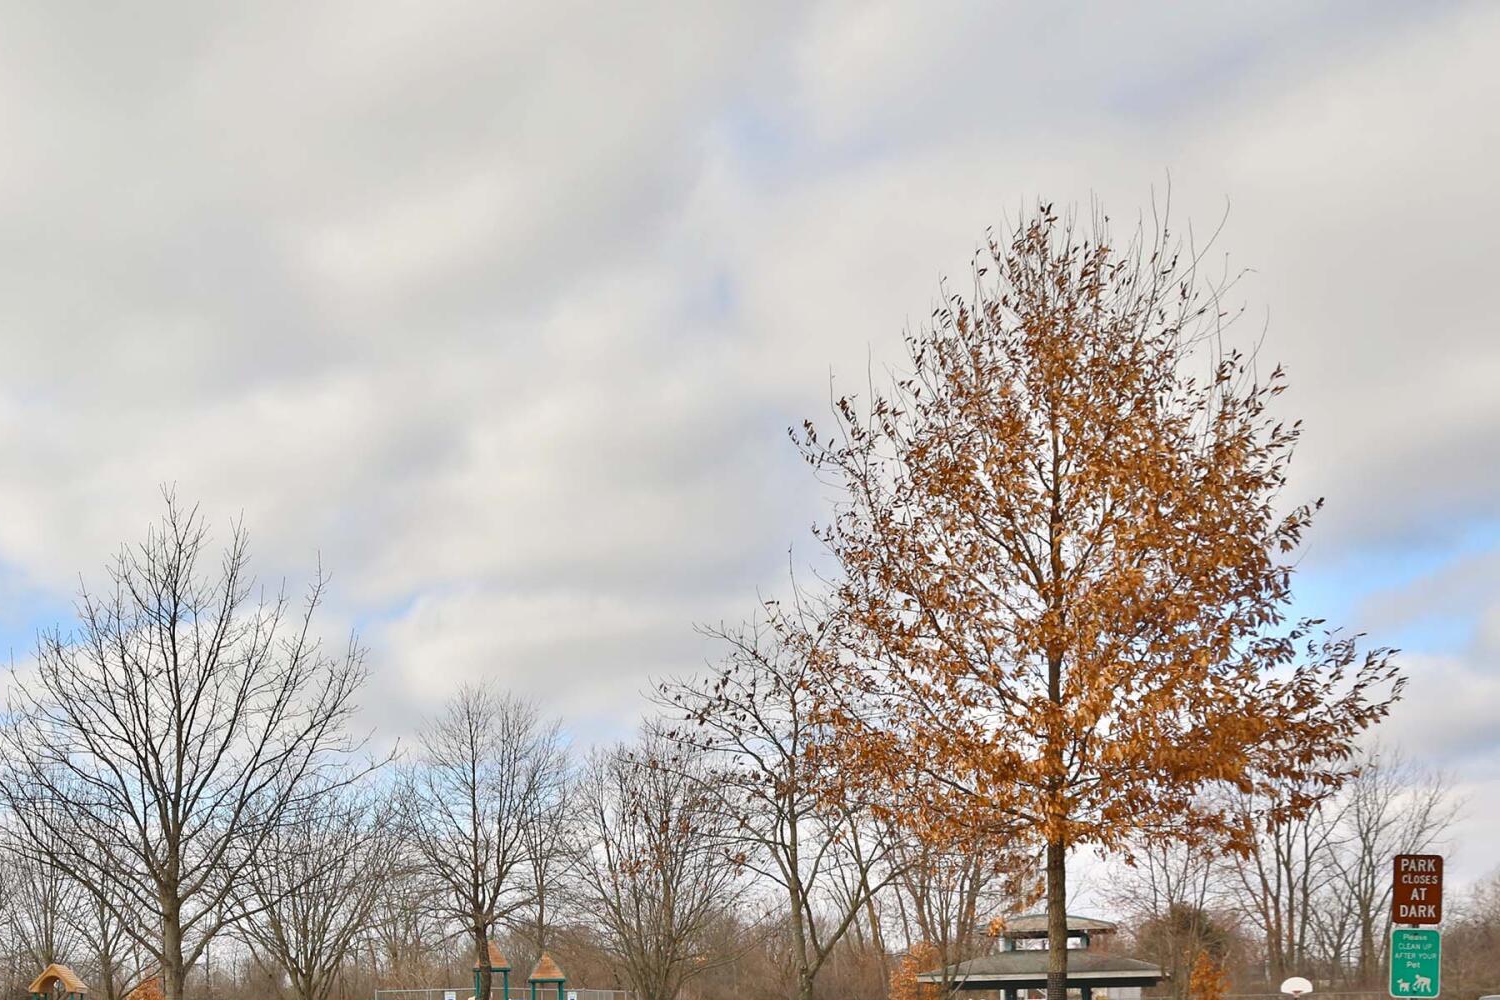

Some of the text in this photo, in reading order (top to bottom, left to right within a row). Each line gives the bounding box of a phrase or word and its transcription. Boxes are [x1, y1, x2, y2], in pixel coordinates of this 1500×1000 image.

[1400, 858, 1436, 872] PARK
[1402, 874, 1438, 884] CLOSES
[1410, 887, 1428, 901] AT
[1399, 904, 1436, 918] DARK
[1398, 942, 1433, 950] CLEAN UP
[1395, 952, 1437, 960] AFTER YOUR
[1406, 960, 1421, 969] Pet
